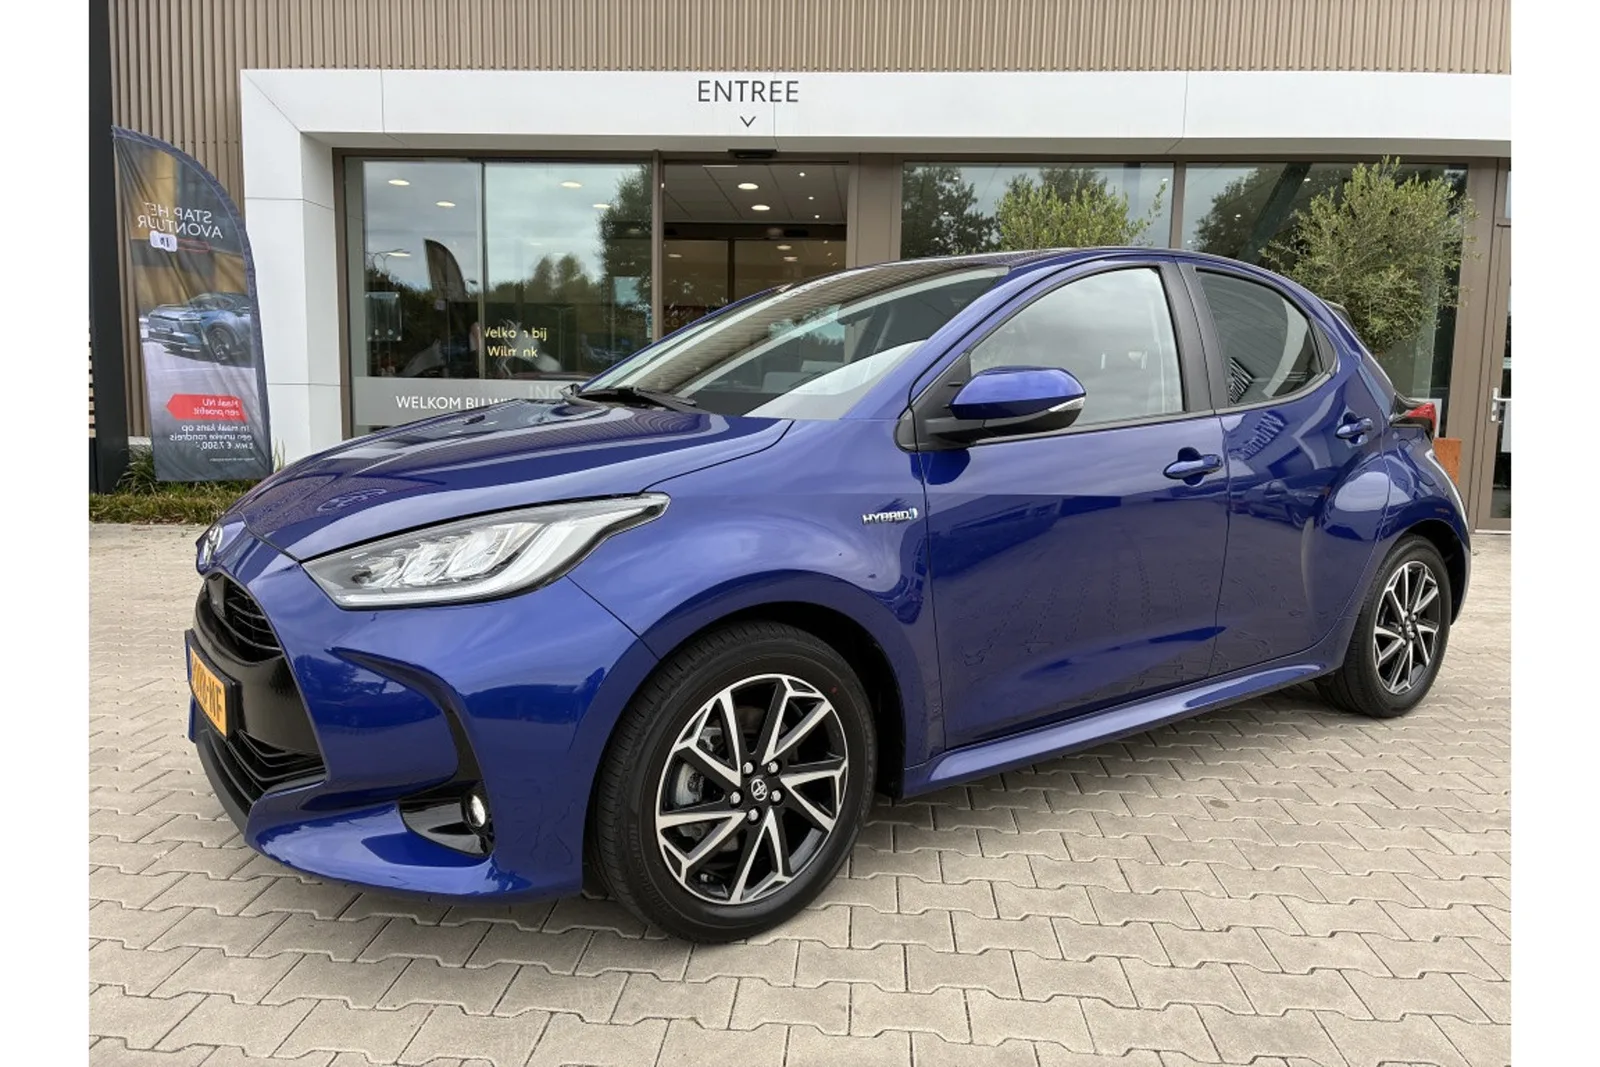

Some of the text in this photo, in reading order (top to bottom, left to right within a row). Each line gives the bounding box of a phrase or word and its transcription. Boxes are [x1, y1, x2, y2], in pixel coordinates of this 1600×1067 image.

[697, 80, 800, 103] ENTREE
[531, 326, 548, 341] bij
[486, 345, 538, 358] Wilmnk
[395, 395, 461, 410] WELKOM
[861, 510, 910, 525] HYBRID
